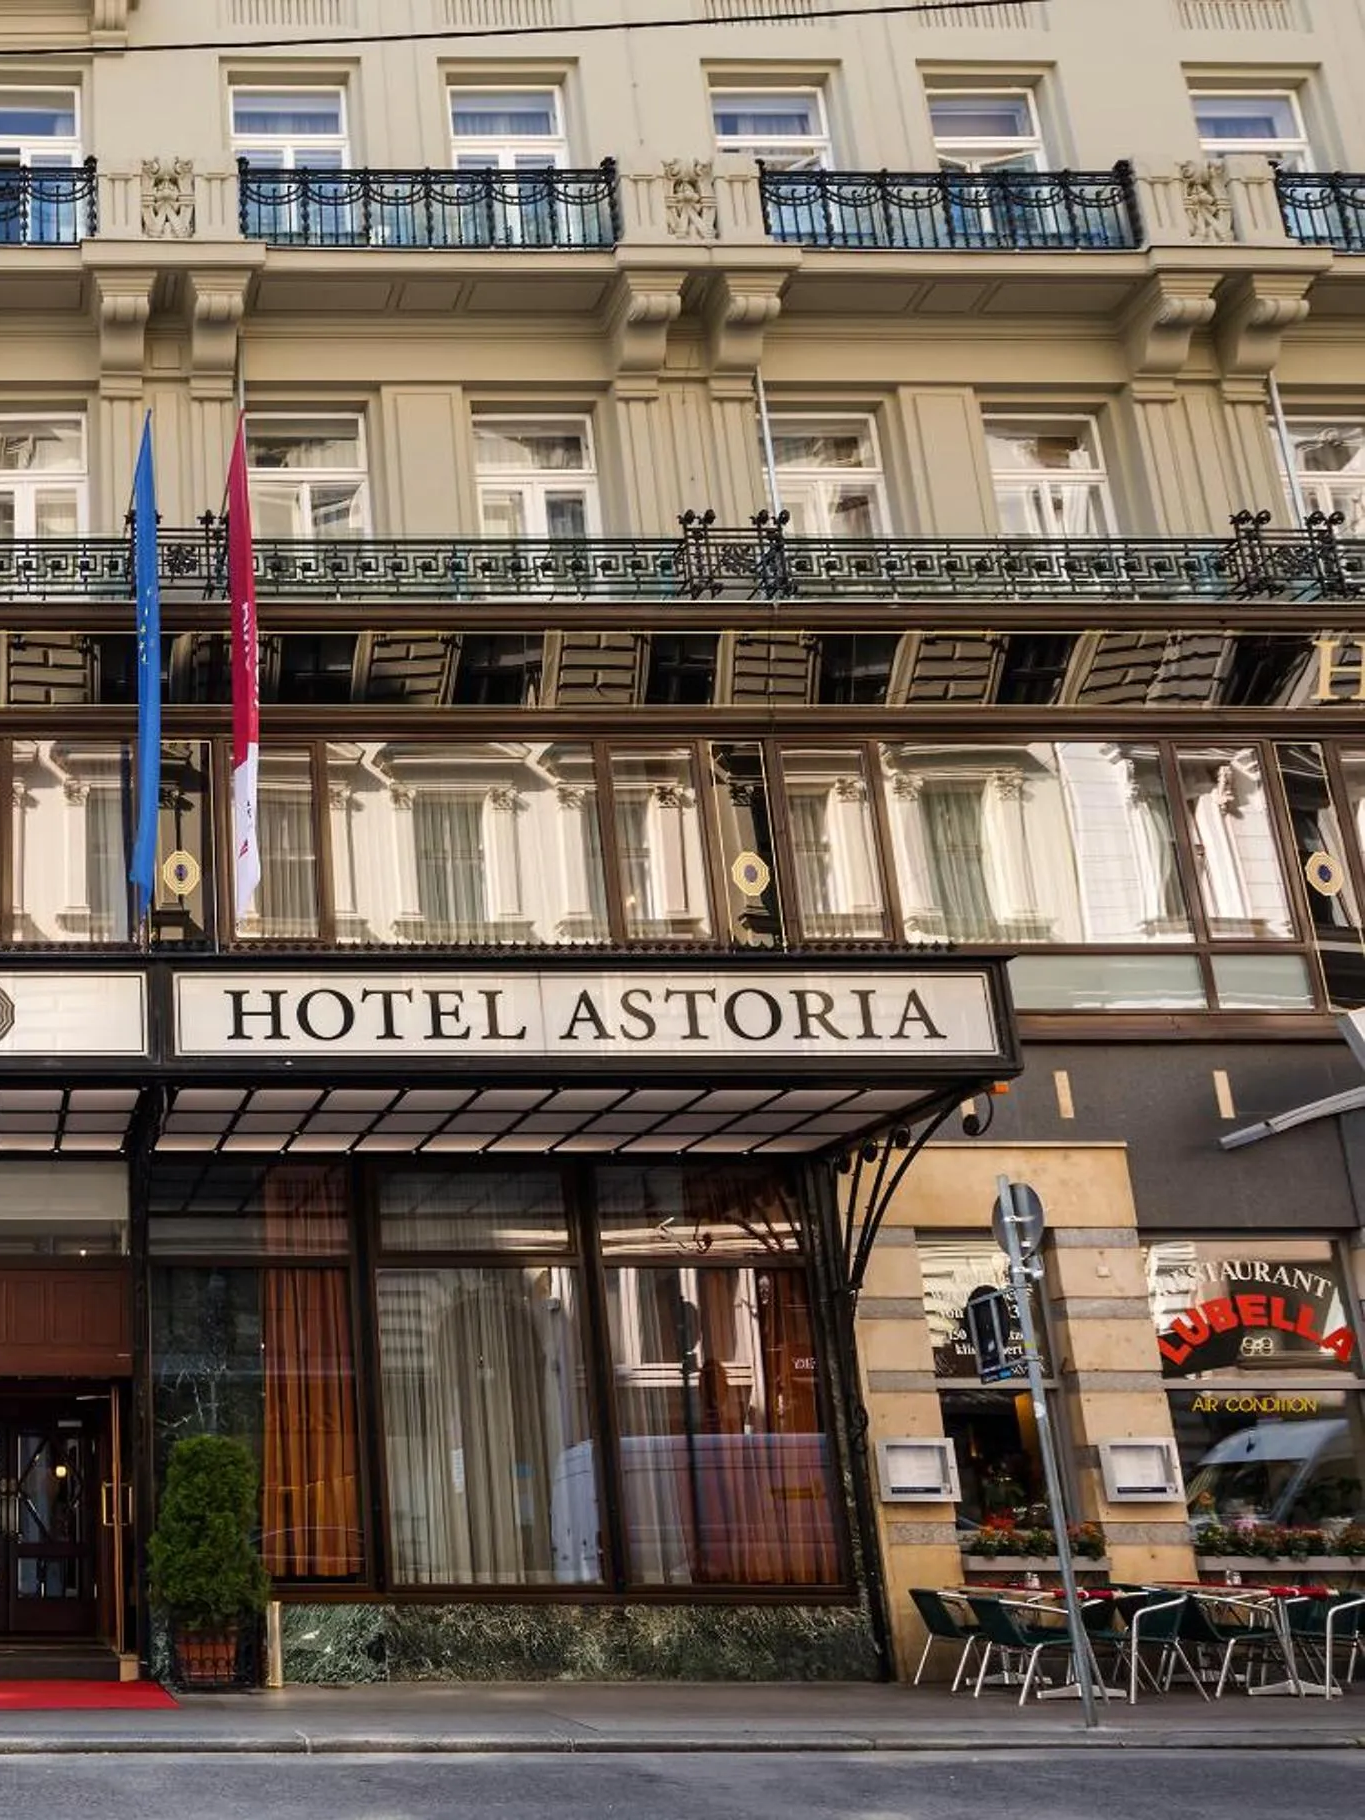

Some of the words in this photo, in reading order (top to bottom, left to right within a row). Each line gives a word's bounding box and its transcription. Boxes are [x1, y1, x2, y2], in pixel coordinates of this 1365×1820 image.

[223, 987, 527, 1041] HOTEL
[559, 987, 948, 1041] ASTORIA
[1157, 1293, 1356, 1366] LUBELLA
[1191, 1397, 1219, 1413] AIR
[1225, 1396, 1317, 1414] CONDITION
